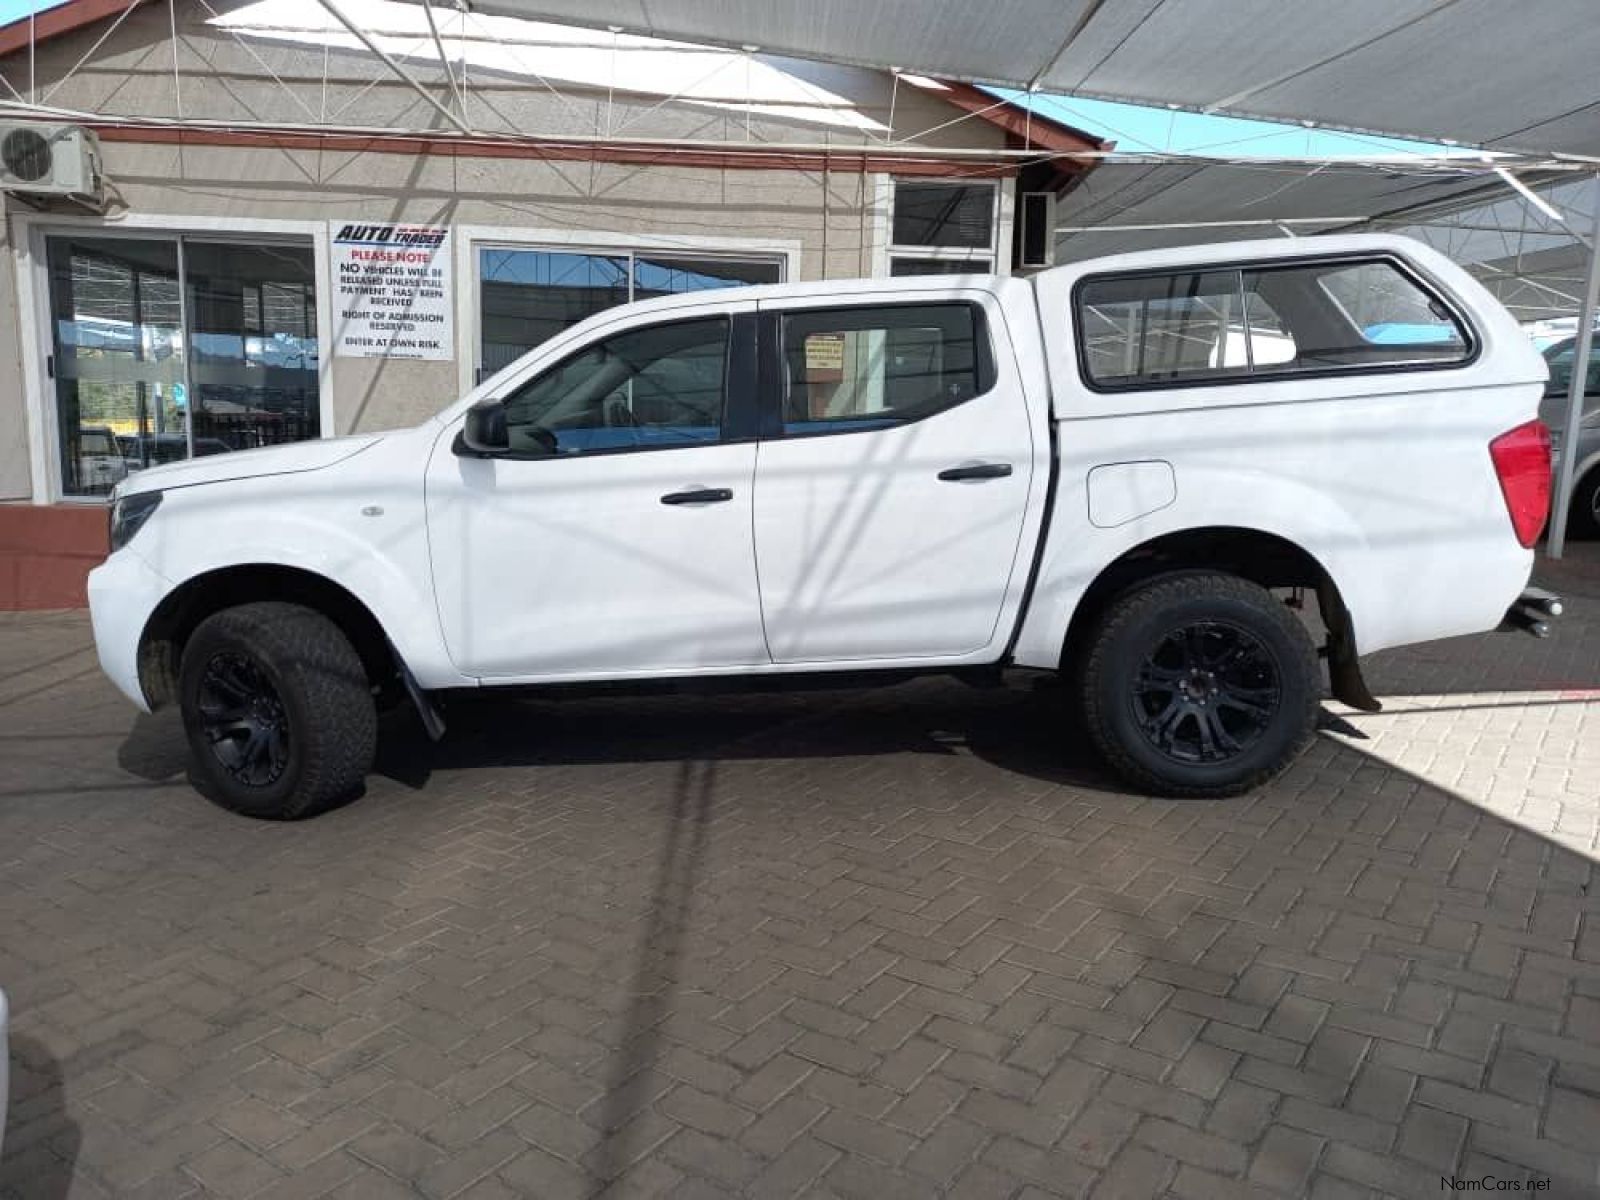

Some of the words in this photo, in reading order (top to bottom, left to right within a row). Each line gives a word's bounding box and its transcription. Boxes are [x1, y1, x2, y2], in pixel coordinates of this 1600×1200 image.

[336, 225, 394, 241] AUTO
[352, 251, 393, 261] PLEASE
[396, 252, 430, 262] NOTE
[341, 264, 360, 272] NO
[363, 266, 404, 275] VEHICLES
[386, 278, 420, 286] UNLESS
[341, 286, 386, 295] PAYMENT
[371, 298, 412, 306] RECEIVED
[342, 310, 370, 319] RIGHT
[373, 312, 385, 320] OF
[389, 312, 444, 322] ADMISSION
[370, 322, 414, 331] RESERVED
[345, 338, 373, 346] ENTER
[390, 339, 416, 347] OWN
